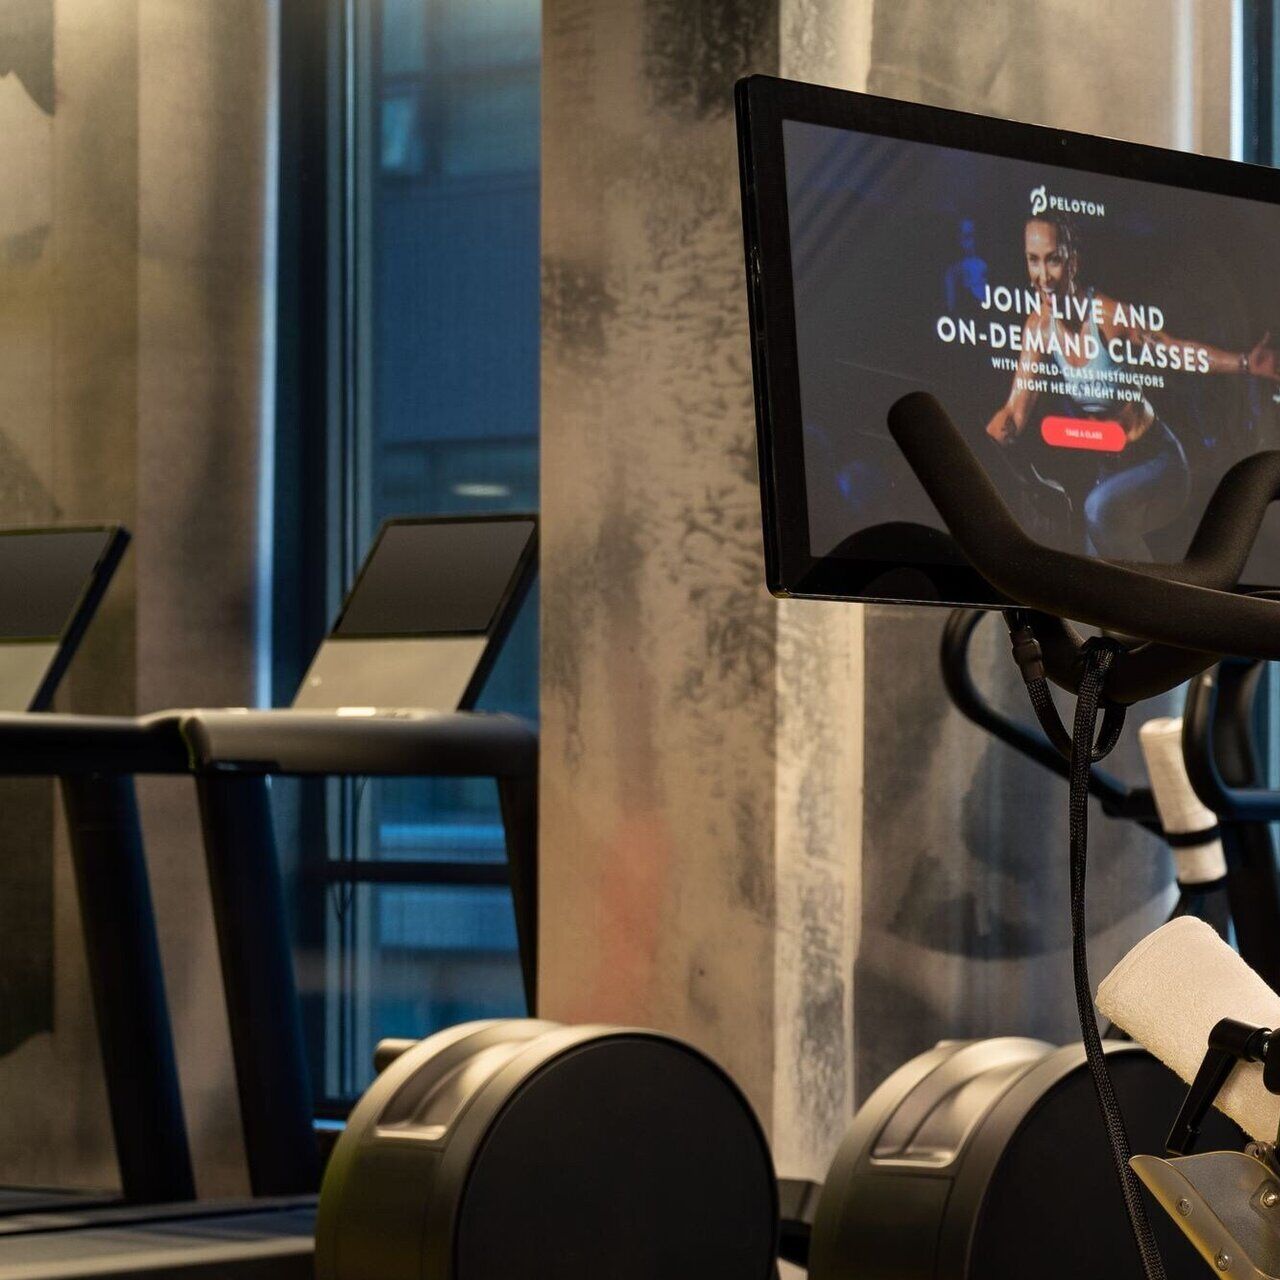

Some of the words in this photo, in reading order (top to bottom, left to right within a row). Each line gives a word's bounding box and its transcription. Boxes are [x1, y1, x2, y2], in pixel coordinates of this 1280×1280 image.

[1048, 194, 1105, 217] PELOTON
[981, 284, 1042, 316] JOIN
[1051, 292, 1105, 326] LIVE
[1112, 302, 1165, 332] AND
[936, 315, 1100, 360] ON-DEMAND
[1108, 338, 1210, 374] CLASSES
[991, 356, 1019, 372] WITH
[1022, 360, 1093, 381] WORLD-CLASS
[1096, 370, 1165, 389] INSTRUCTORS
[1015, 379, 1048, 393] RIGHT
[1051, 382, 1082, 398] HERE,
[1084, 386, 1114, 400] RIGHT
